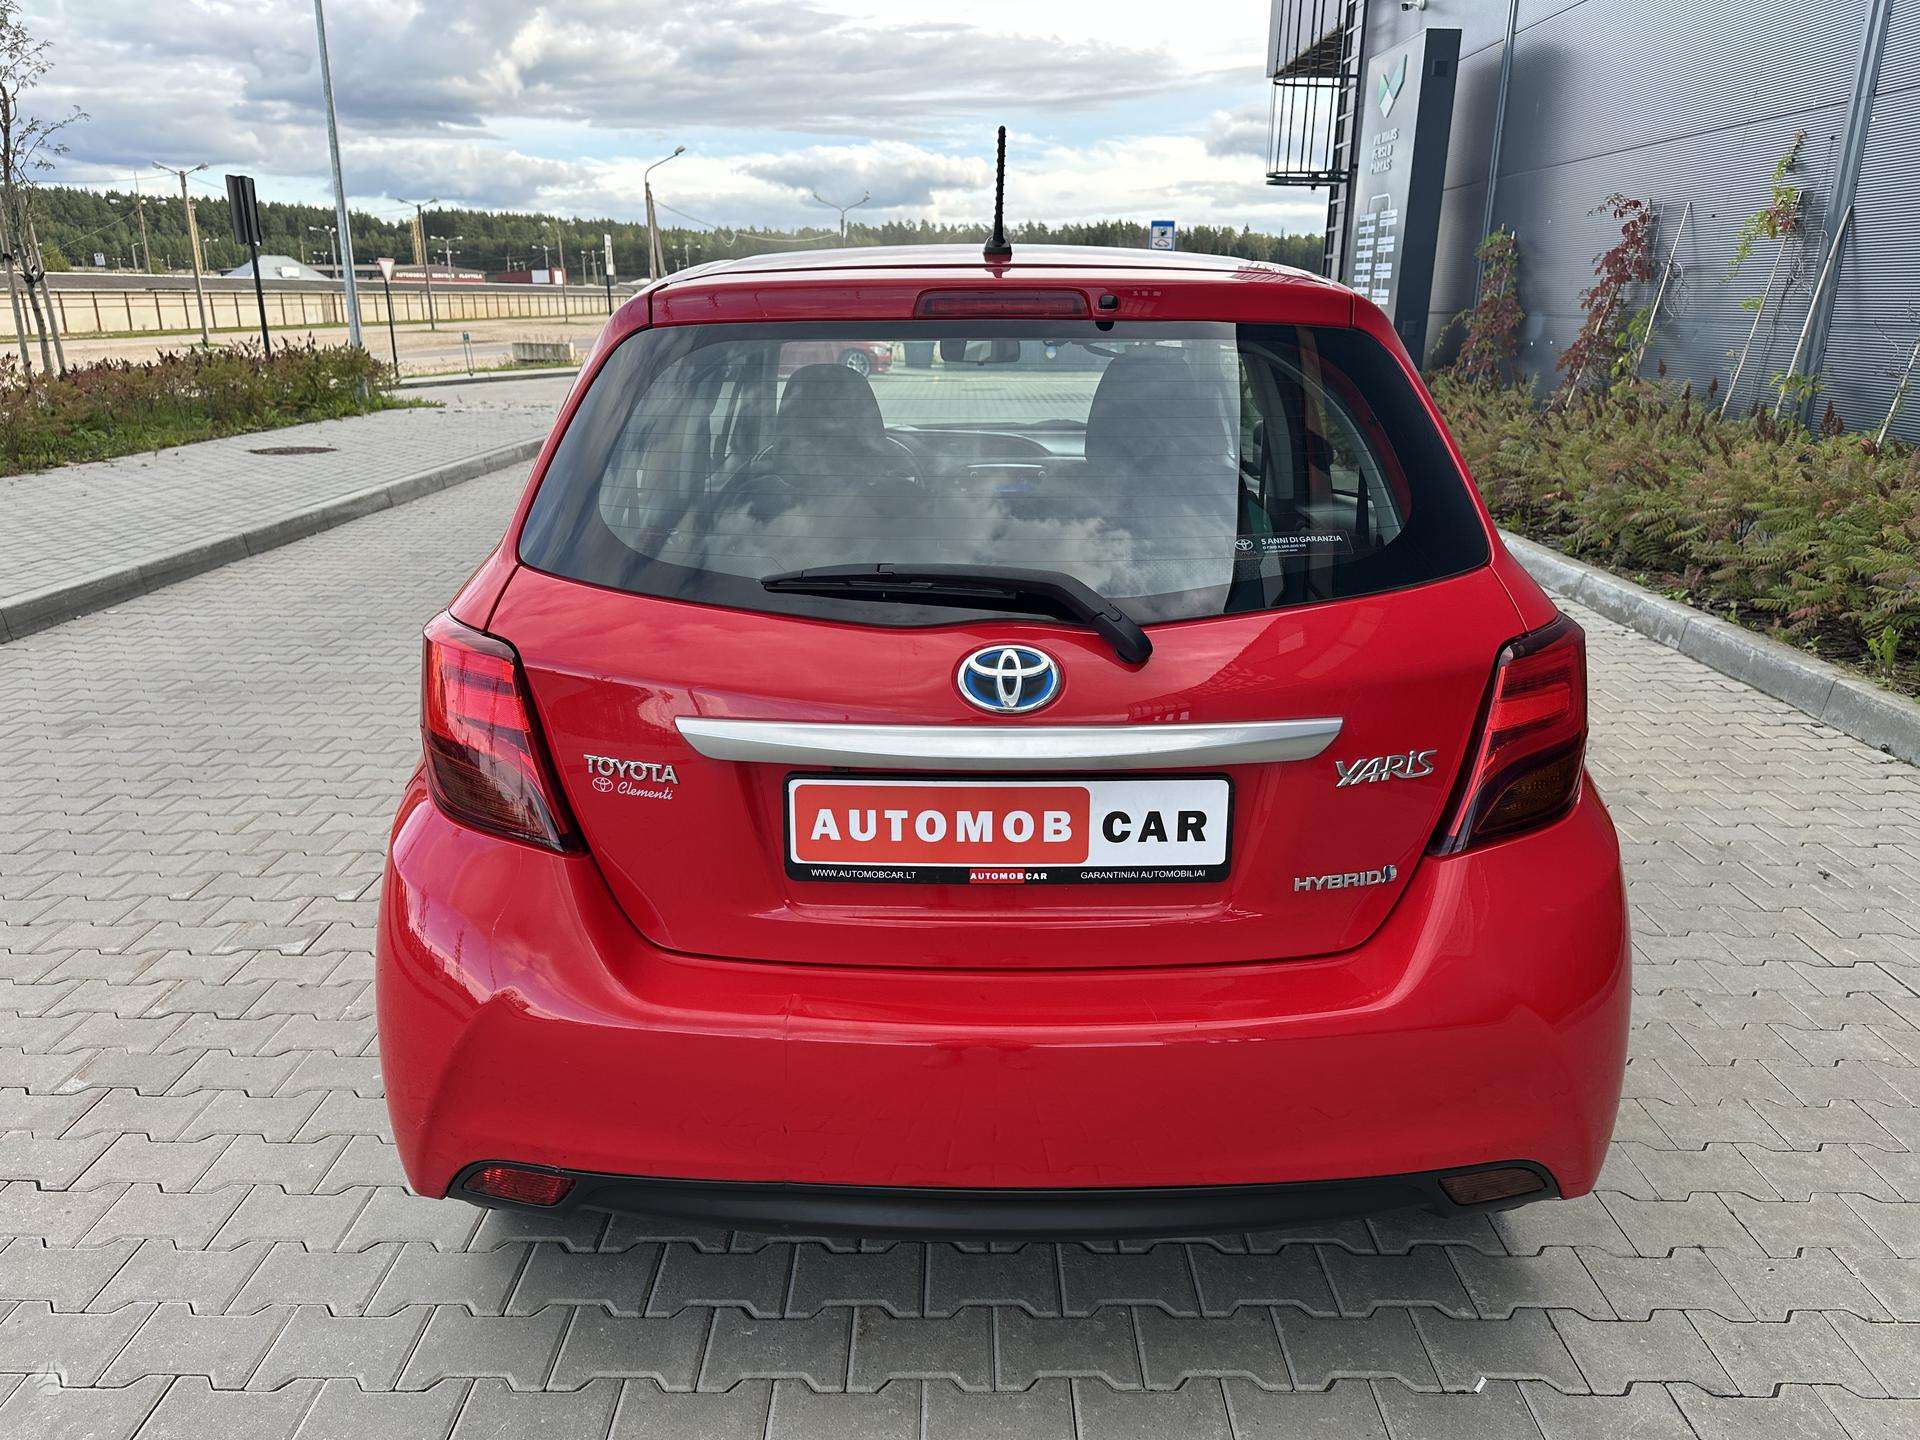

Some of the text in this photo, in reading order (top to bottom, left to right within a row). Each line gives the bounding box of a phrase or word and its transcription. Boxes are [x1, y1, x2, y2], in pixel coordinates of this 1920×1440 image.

[1267, 537, 1288, 545] ANNI
[1300, 535, 1343, 543] GARANZIA
[583, 754, 679, 785] TOYOTA
[617, 781, 674, 800] Clementi
[810, 808, 1207, 843] AUTOMOB CAR
[811, 869, 917, 880] WWW.AUTOMOBCAR.LT
[1080, 869, 1206, 880] GARANTINIAI AUTOMOBILIAI
[1294, 869, 1382, 892] HYBRID
